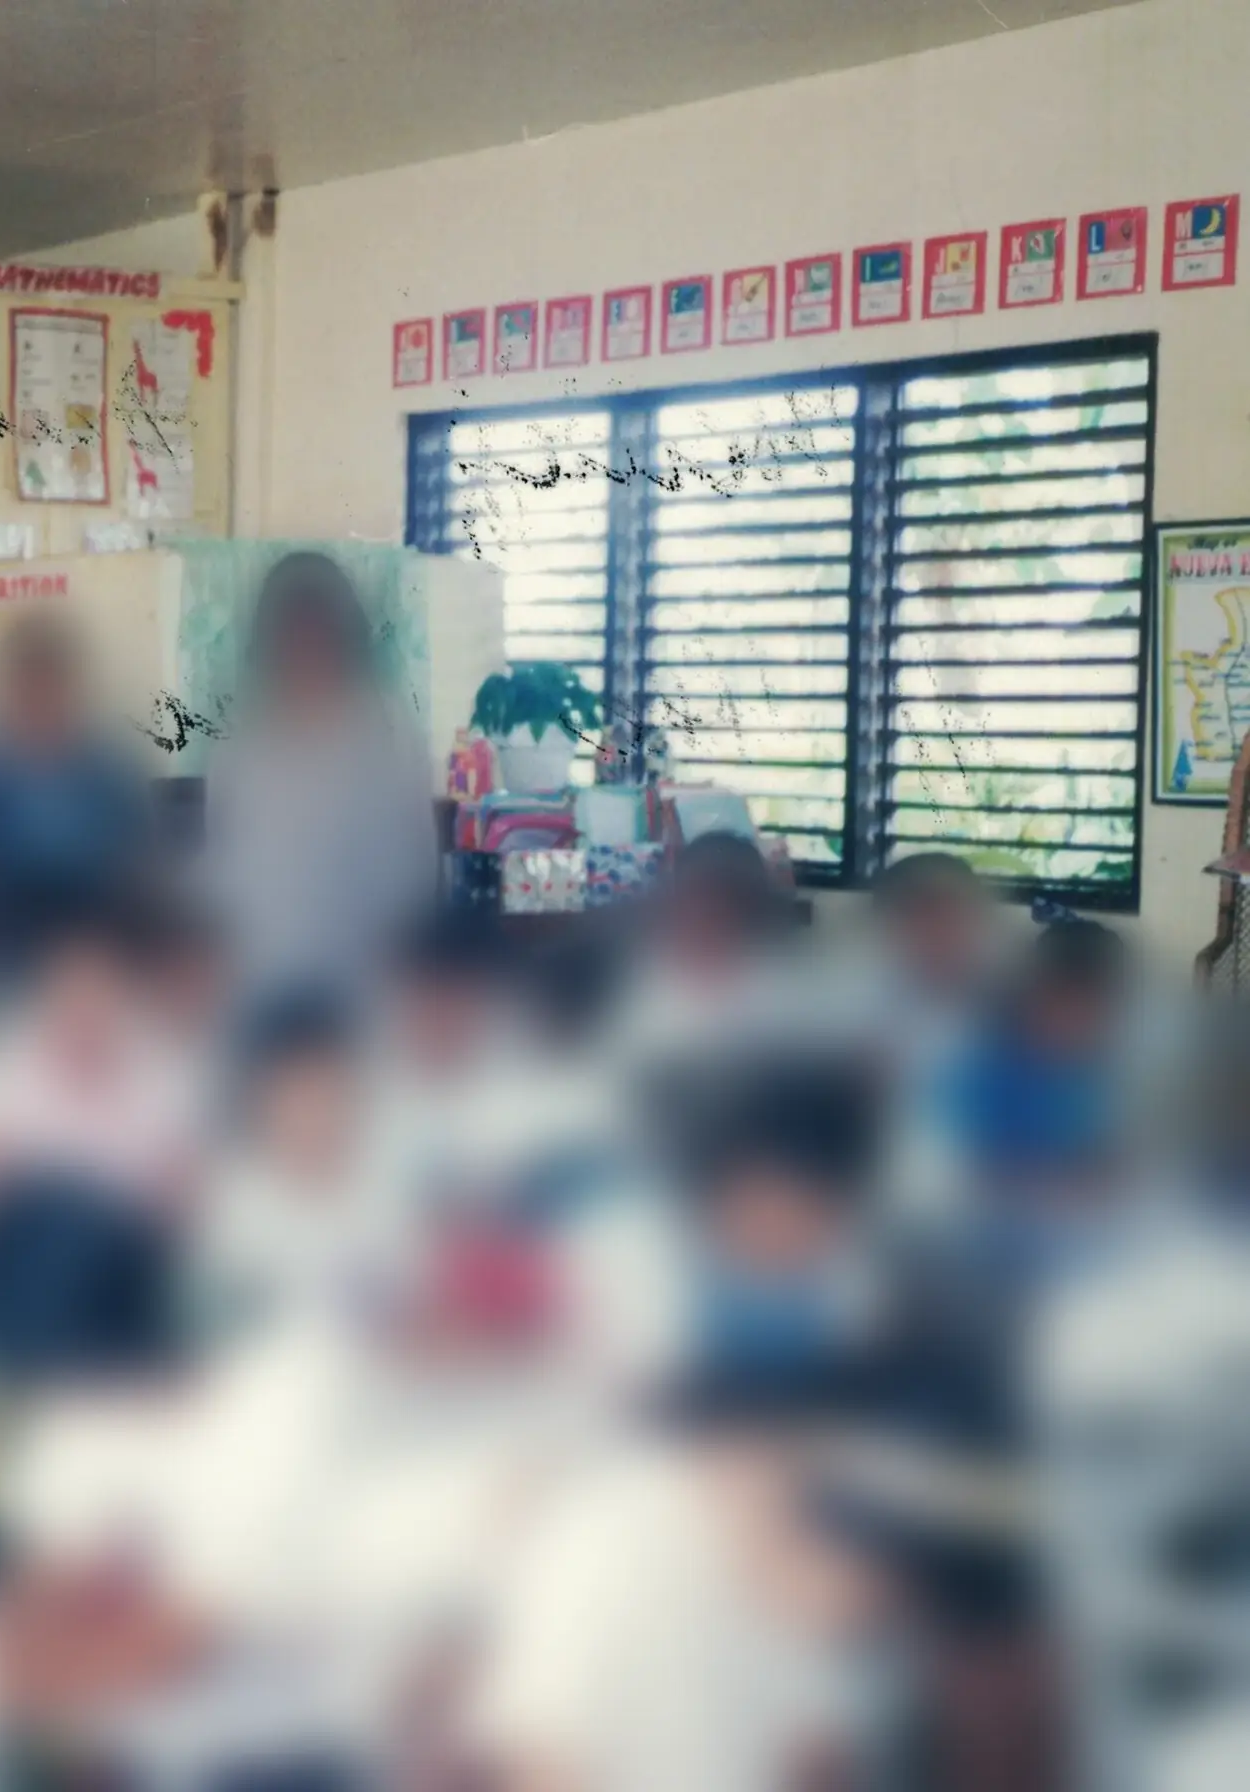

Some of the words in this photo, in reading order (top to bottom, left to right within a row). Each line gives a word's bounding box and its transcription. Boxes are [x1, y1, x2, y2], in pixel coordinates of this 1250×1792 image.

[1090, 223, 1102, 252] L
[1175, 211, 1193, 241] M
[1010, 235, 1023, 264] K
